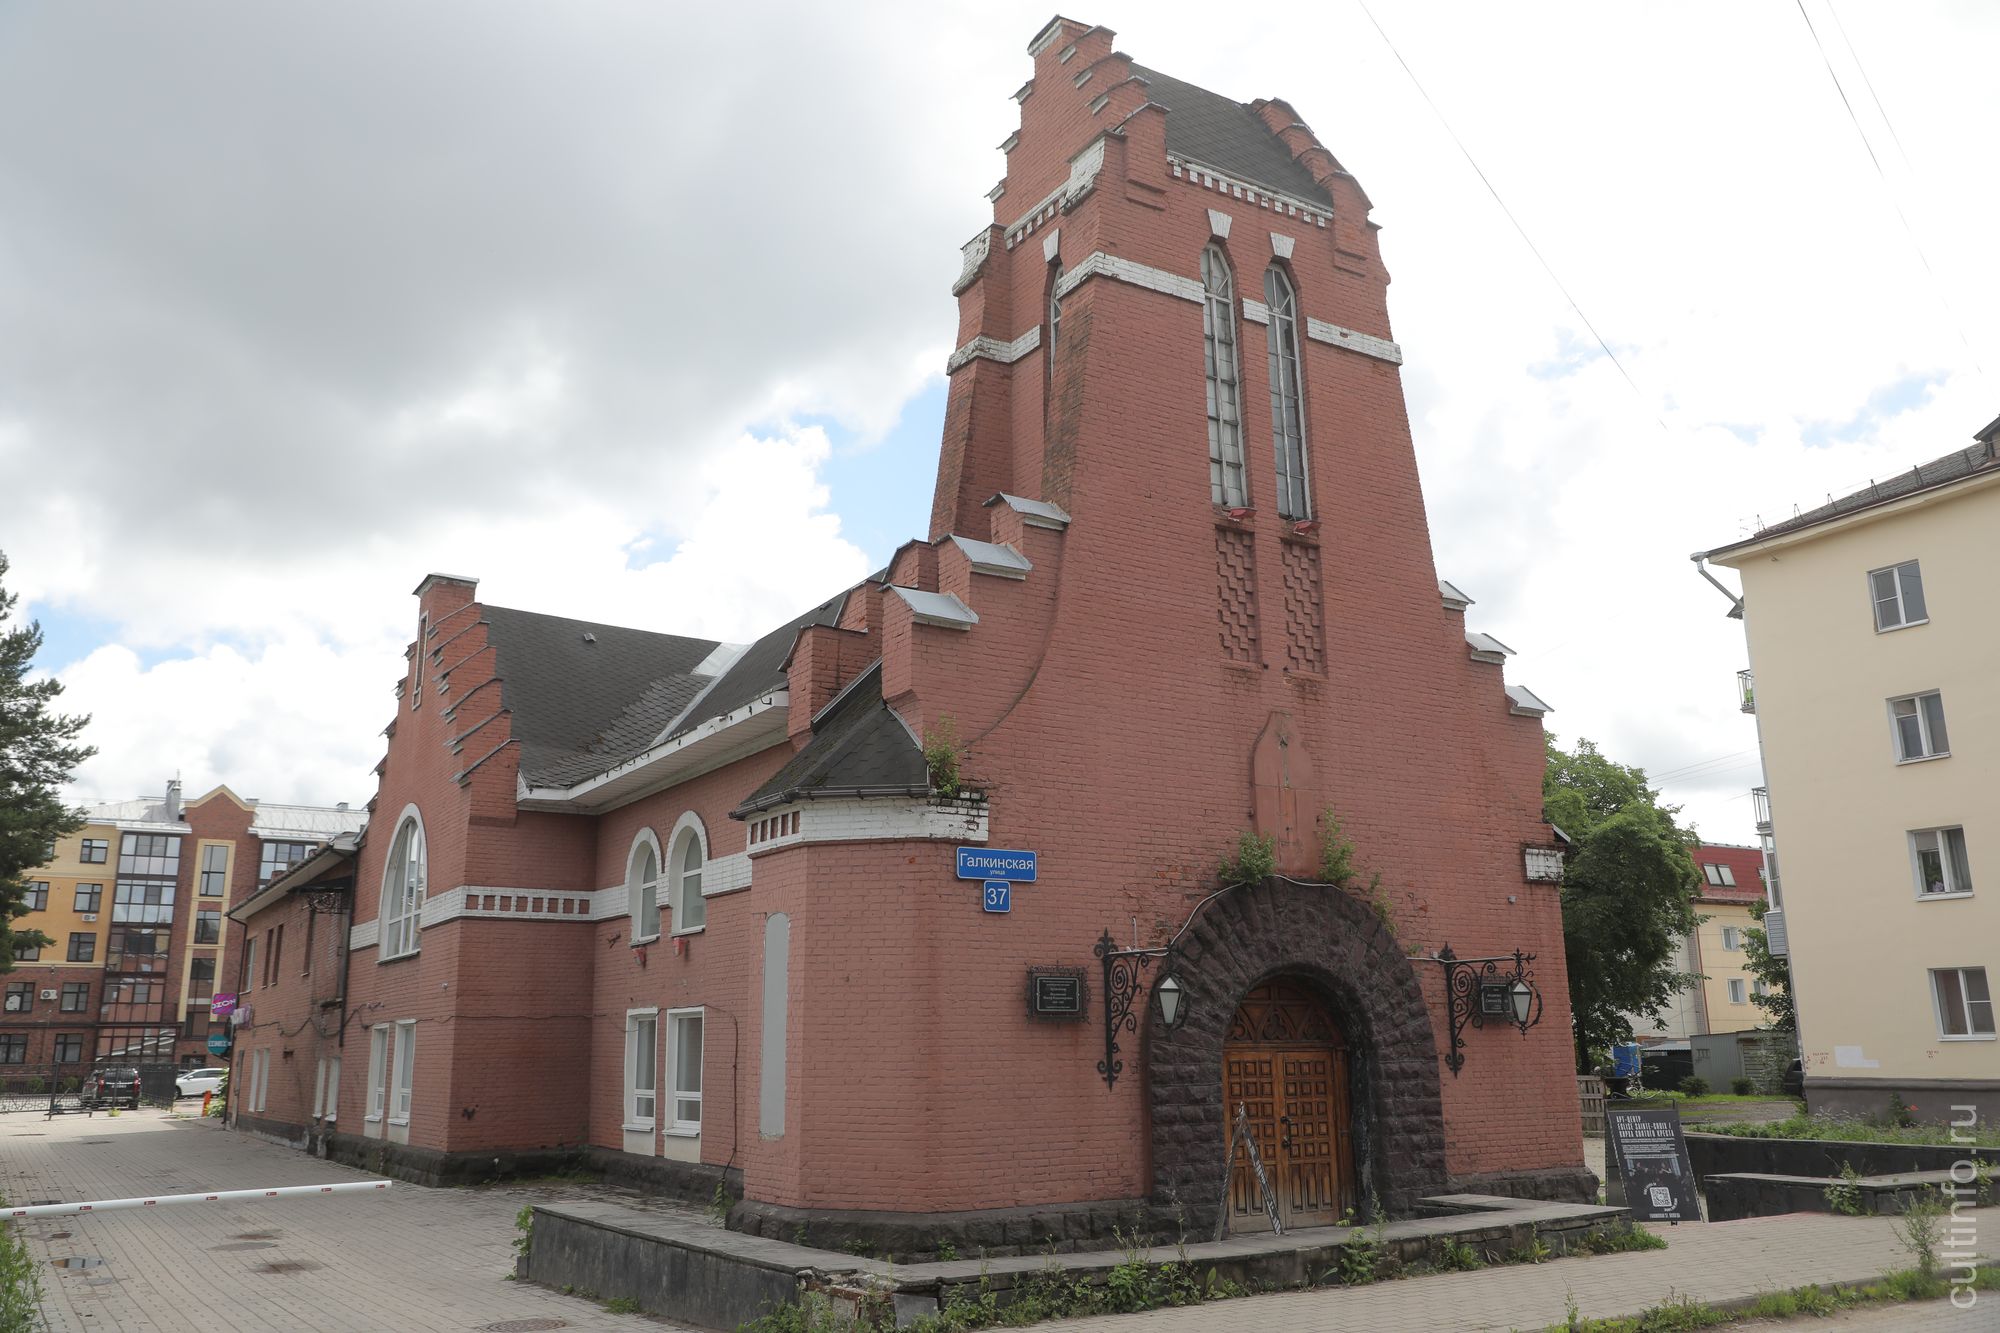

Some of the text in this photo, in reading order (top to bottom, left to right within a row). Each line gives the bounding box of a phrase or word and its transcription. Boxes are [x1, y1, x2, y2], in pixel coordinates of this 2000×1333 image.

[960, 853, 1034, 870] Галкинская
[987, 888, 1007, 905] 37
[211, 998, 236, 1010] OZON
